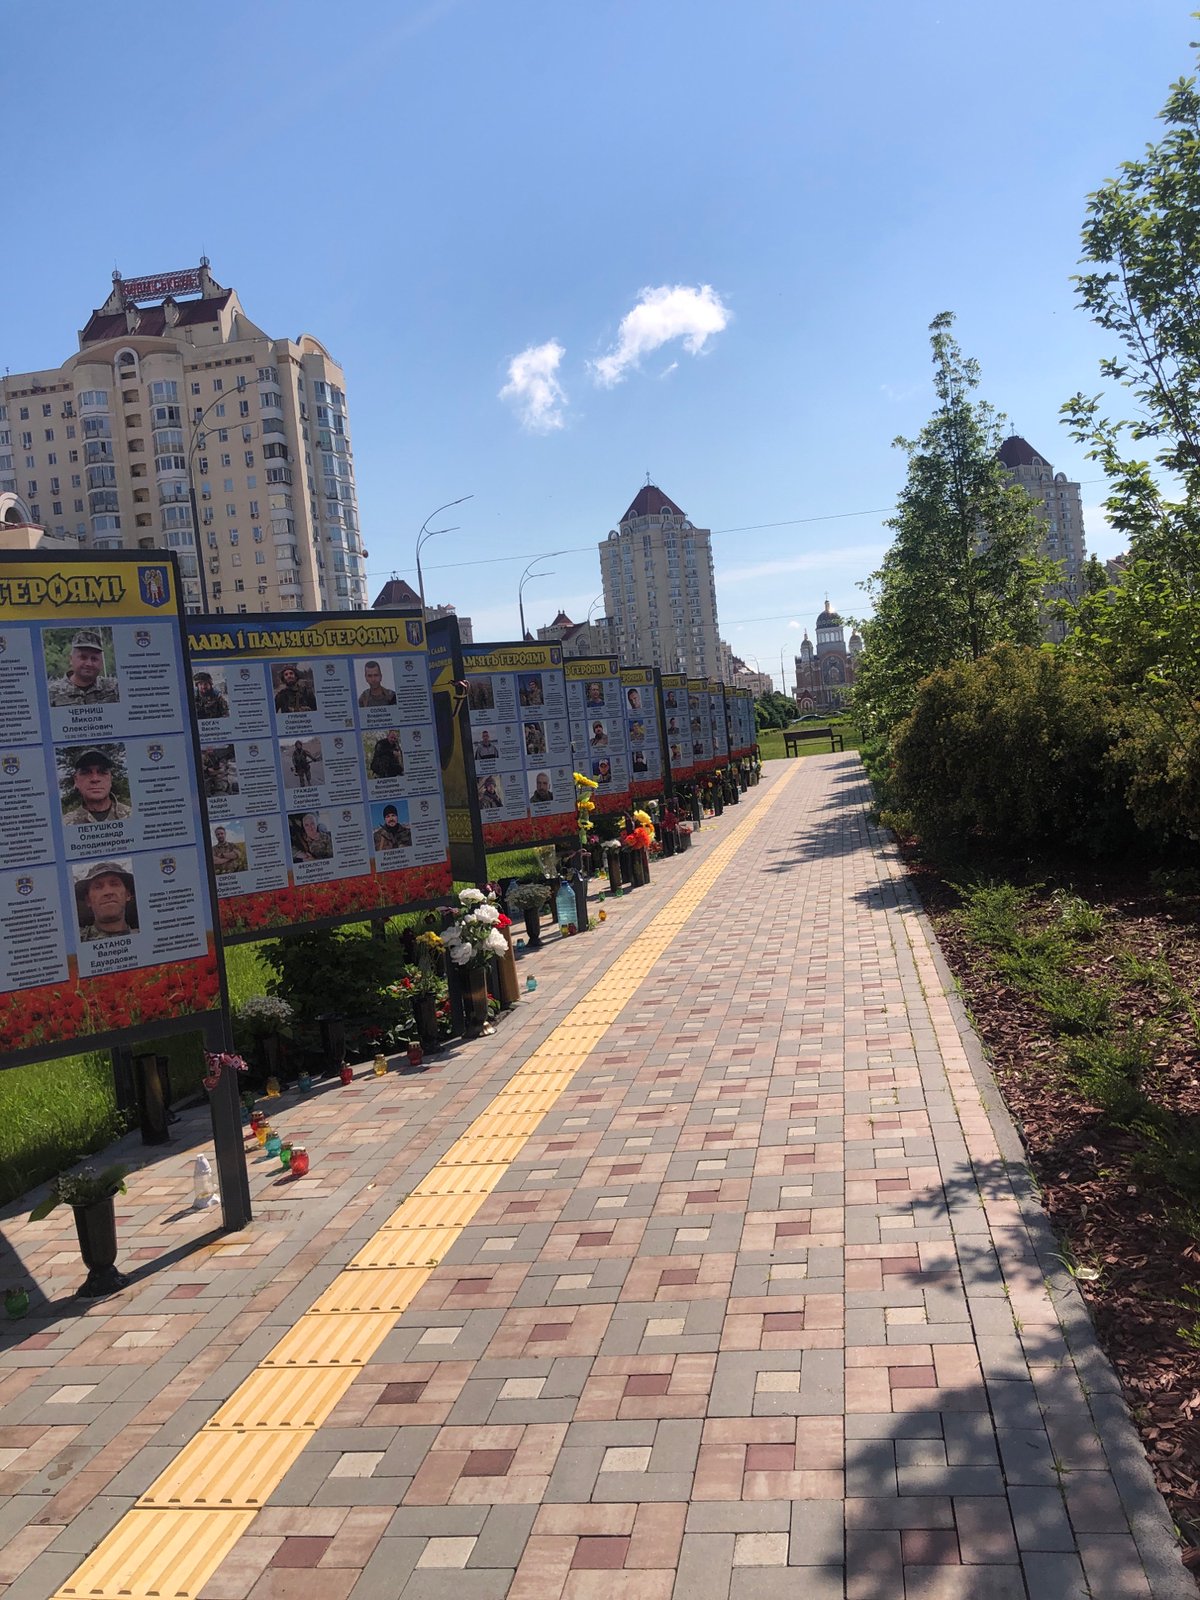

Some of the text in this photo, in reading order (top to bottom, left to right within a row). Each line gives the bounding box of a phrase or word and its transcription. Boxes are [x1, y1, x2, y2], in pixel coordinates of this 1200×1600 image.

[325, 626, 399, 647] ГЕРОЯМ!
[500, 651, 546, 666] ГЕРОЯМ!
[68, 707, 104, 716] ЧЕРНИШ
[62, 724, 113, 733] Олексійович
[77, 821, 124, 833] ПЕТУШКОВ
[79, 830, 124, 841] Олександр
[70, 838, 134, 851] Володимирович
[92, 938, 132, 950] КАТАНОВ
[97, 947, 129, 958] Валерій
[90, 955, 138, 968] Едуардович
